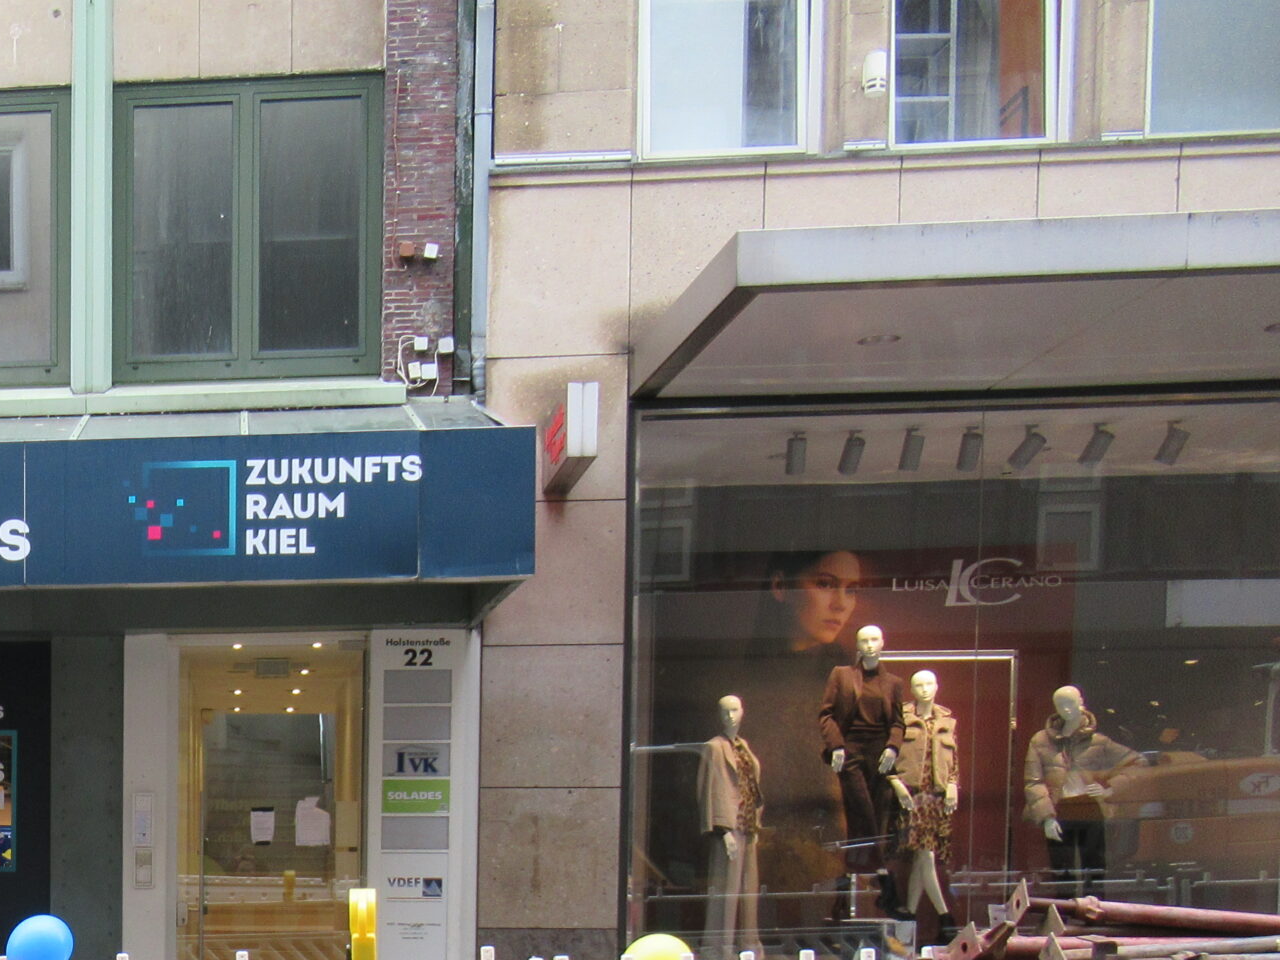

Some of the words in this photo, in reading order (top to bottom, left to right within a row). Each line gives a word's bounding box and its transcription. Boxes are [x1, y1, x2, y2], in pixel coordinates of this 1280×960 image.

[245, 455, 423, 485] ZUKUNFTS
[245, 491, 345, 520] RAUM
[245, 527, 316, 555] KIEL
[891, 577, 951, 592] LUISA
[971, 574, 1062, 590] CERANO
[385, 637, 451, 647] Holstenstraße
[403, 648, 433, 667] 22
[395, 751, 439, 774] IVK
[387, 791, 442, 800] SOLADES
[387, 877, 421, 888] VDEF
